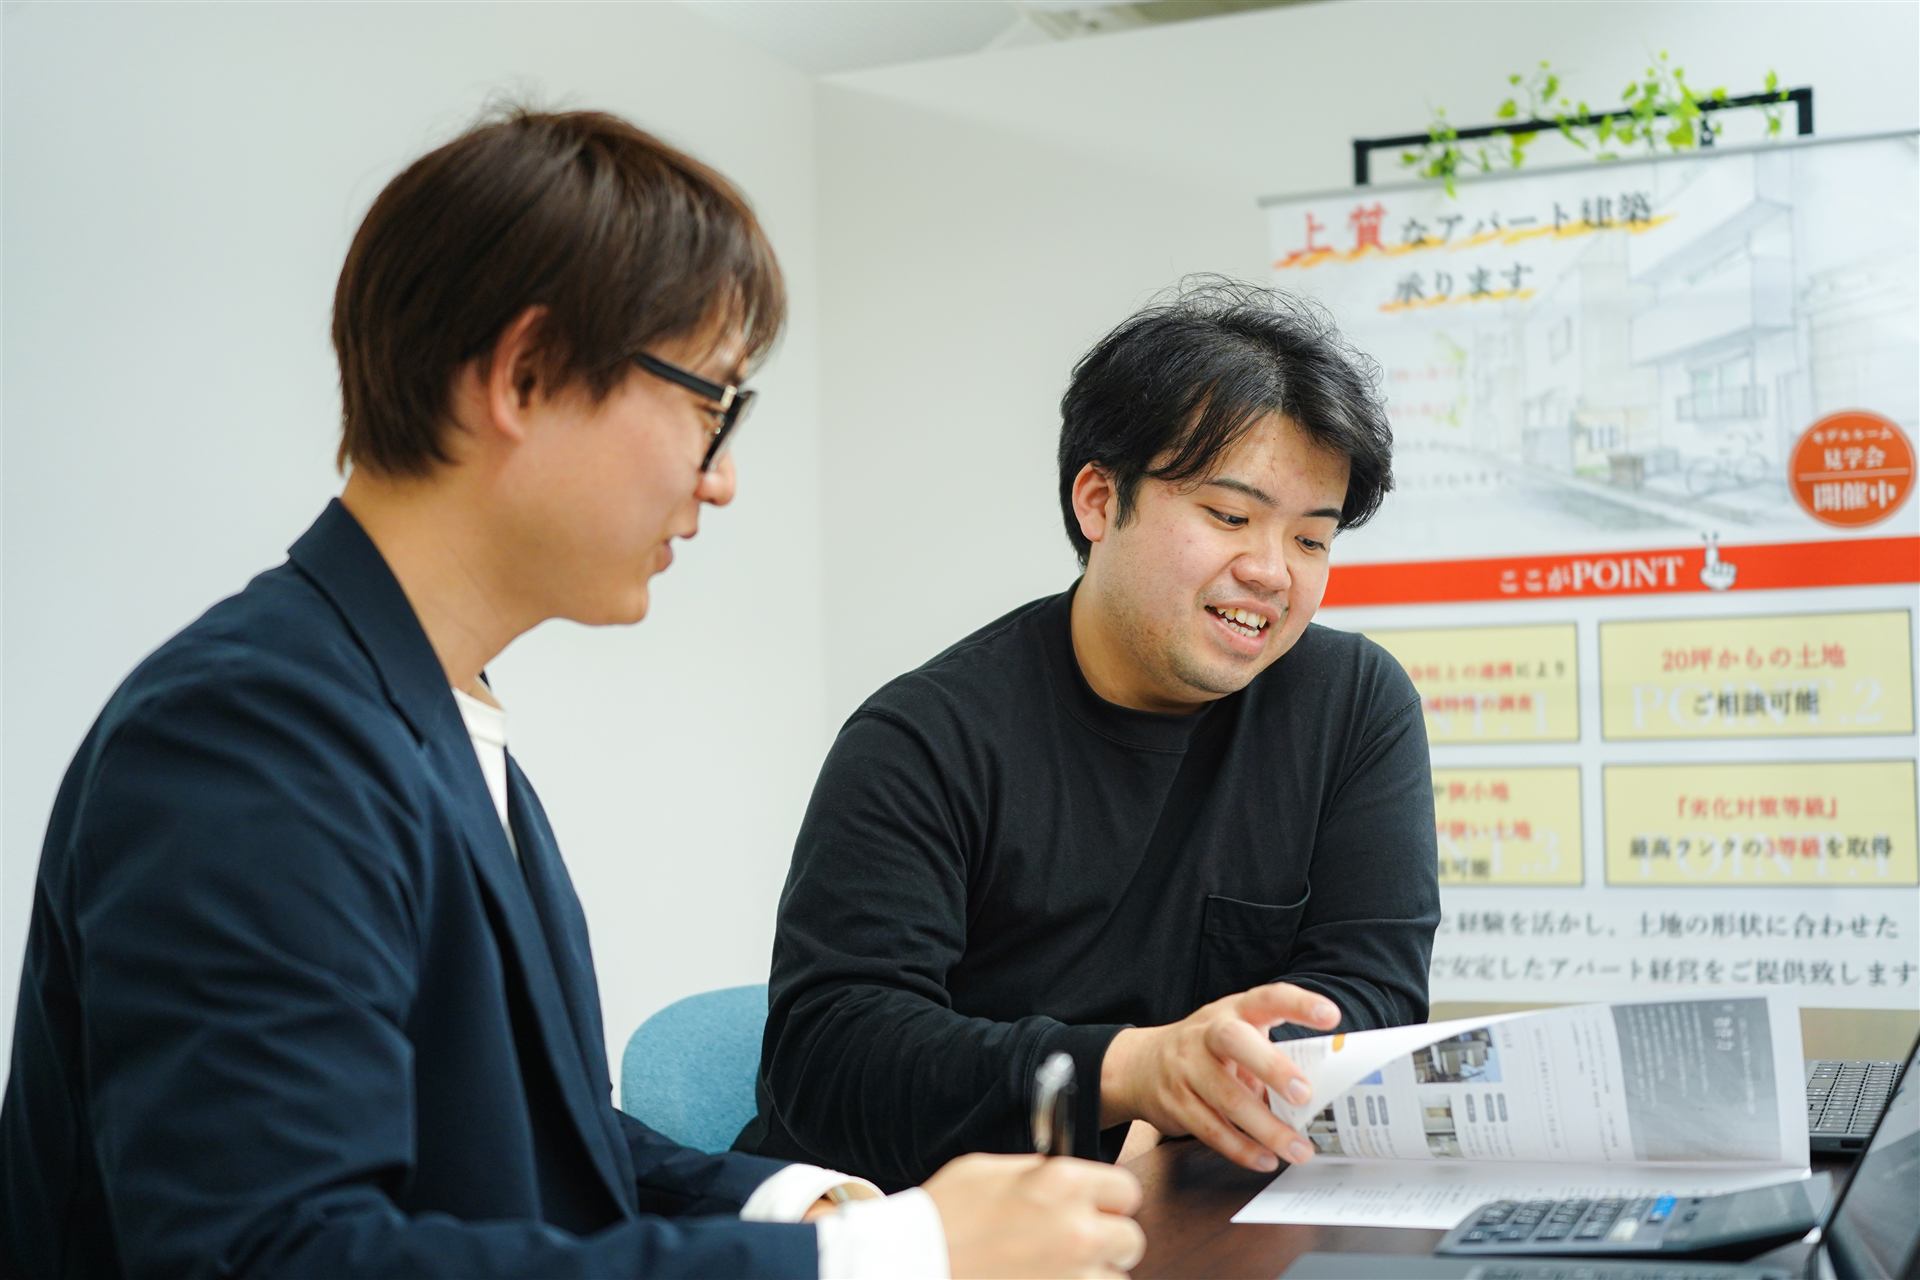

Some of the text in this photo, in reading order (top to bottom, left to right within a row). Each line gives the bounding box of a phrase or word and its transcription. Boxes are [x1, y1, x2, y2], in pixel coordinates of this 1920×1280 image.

[1289, 192, 1653, 252] 上質なアパート建築
[1398, 262, 1533, 303] 承ります
[1500, 555, 1686, 594] ここがPOINT
[1662, 643, 1846, 673] 20坪からの土地
[1692, 688, 1821, 716] ご相談可能
